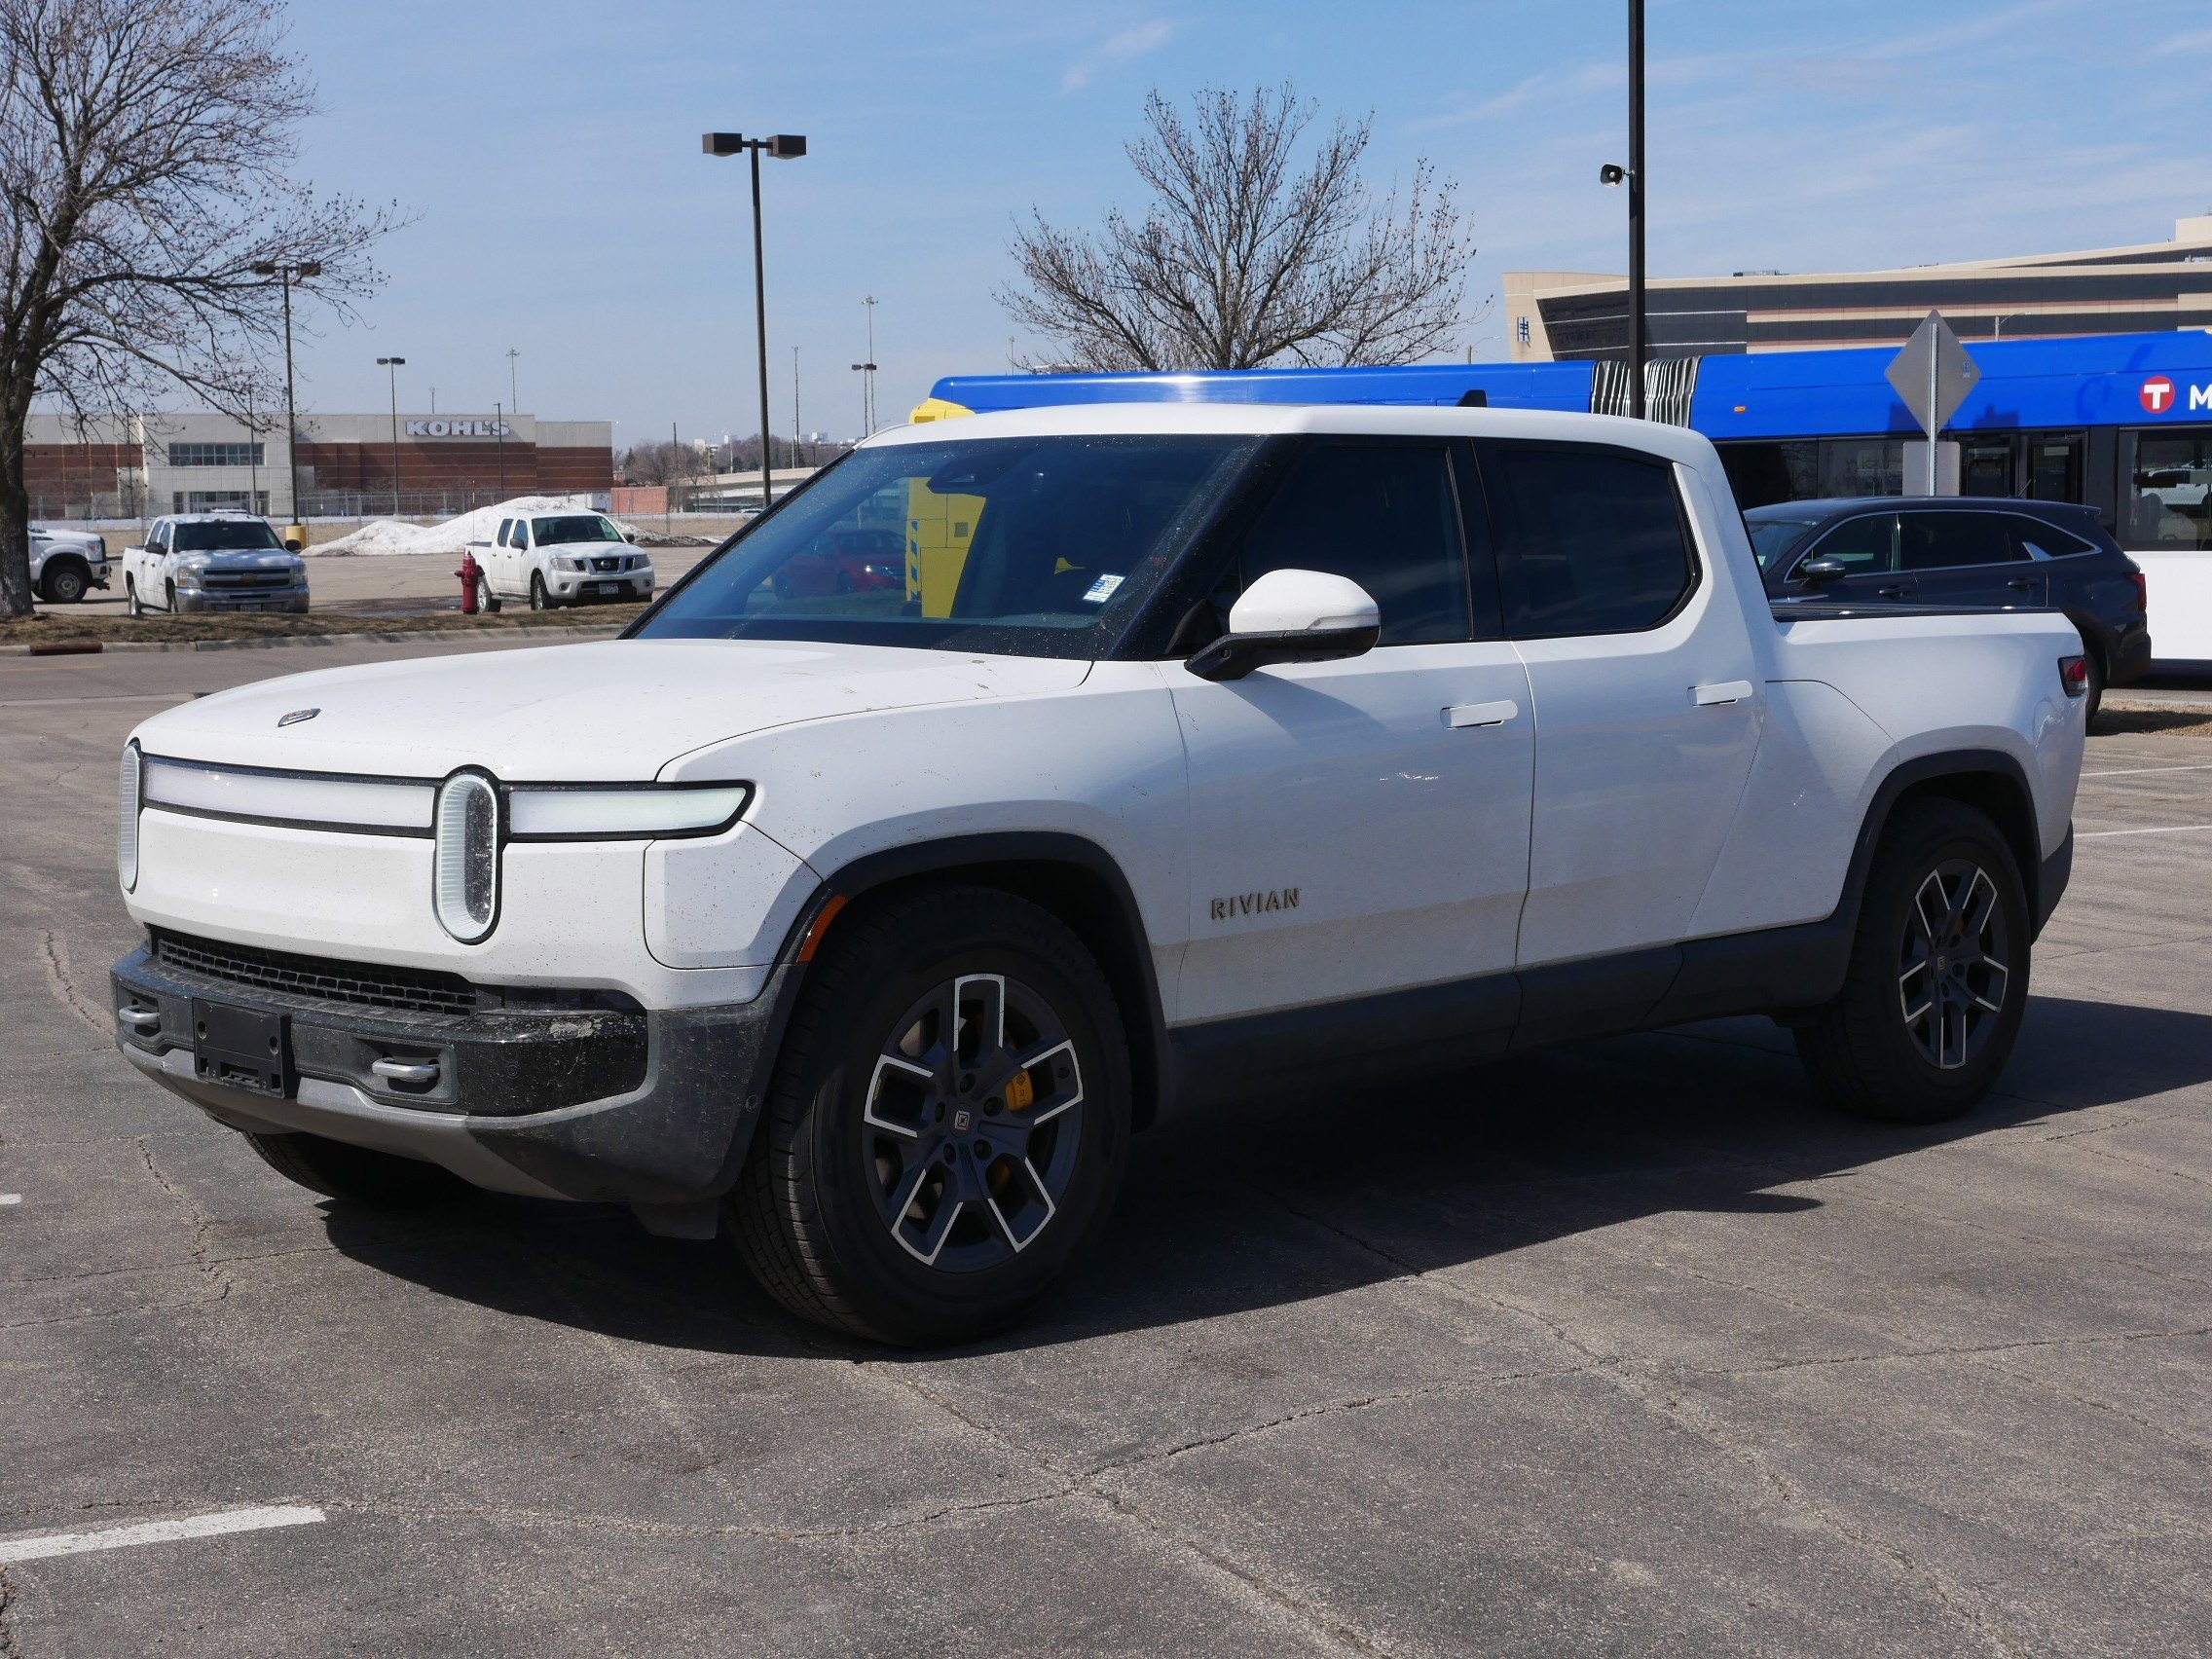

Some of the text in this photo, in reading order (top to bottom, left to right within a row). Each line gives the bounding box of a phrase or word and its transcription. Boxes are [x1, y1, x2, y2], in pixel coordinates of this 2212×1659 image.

[2144, 384, 2170, 409] T
[406, 420, 509, 436] KOHL'S
[1211, 887, 1300, 920] RIVIAN
